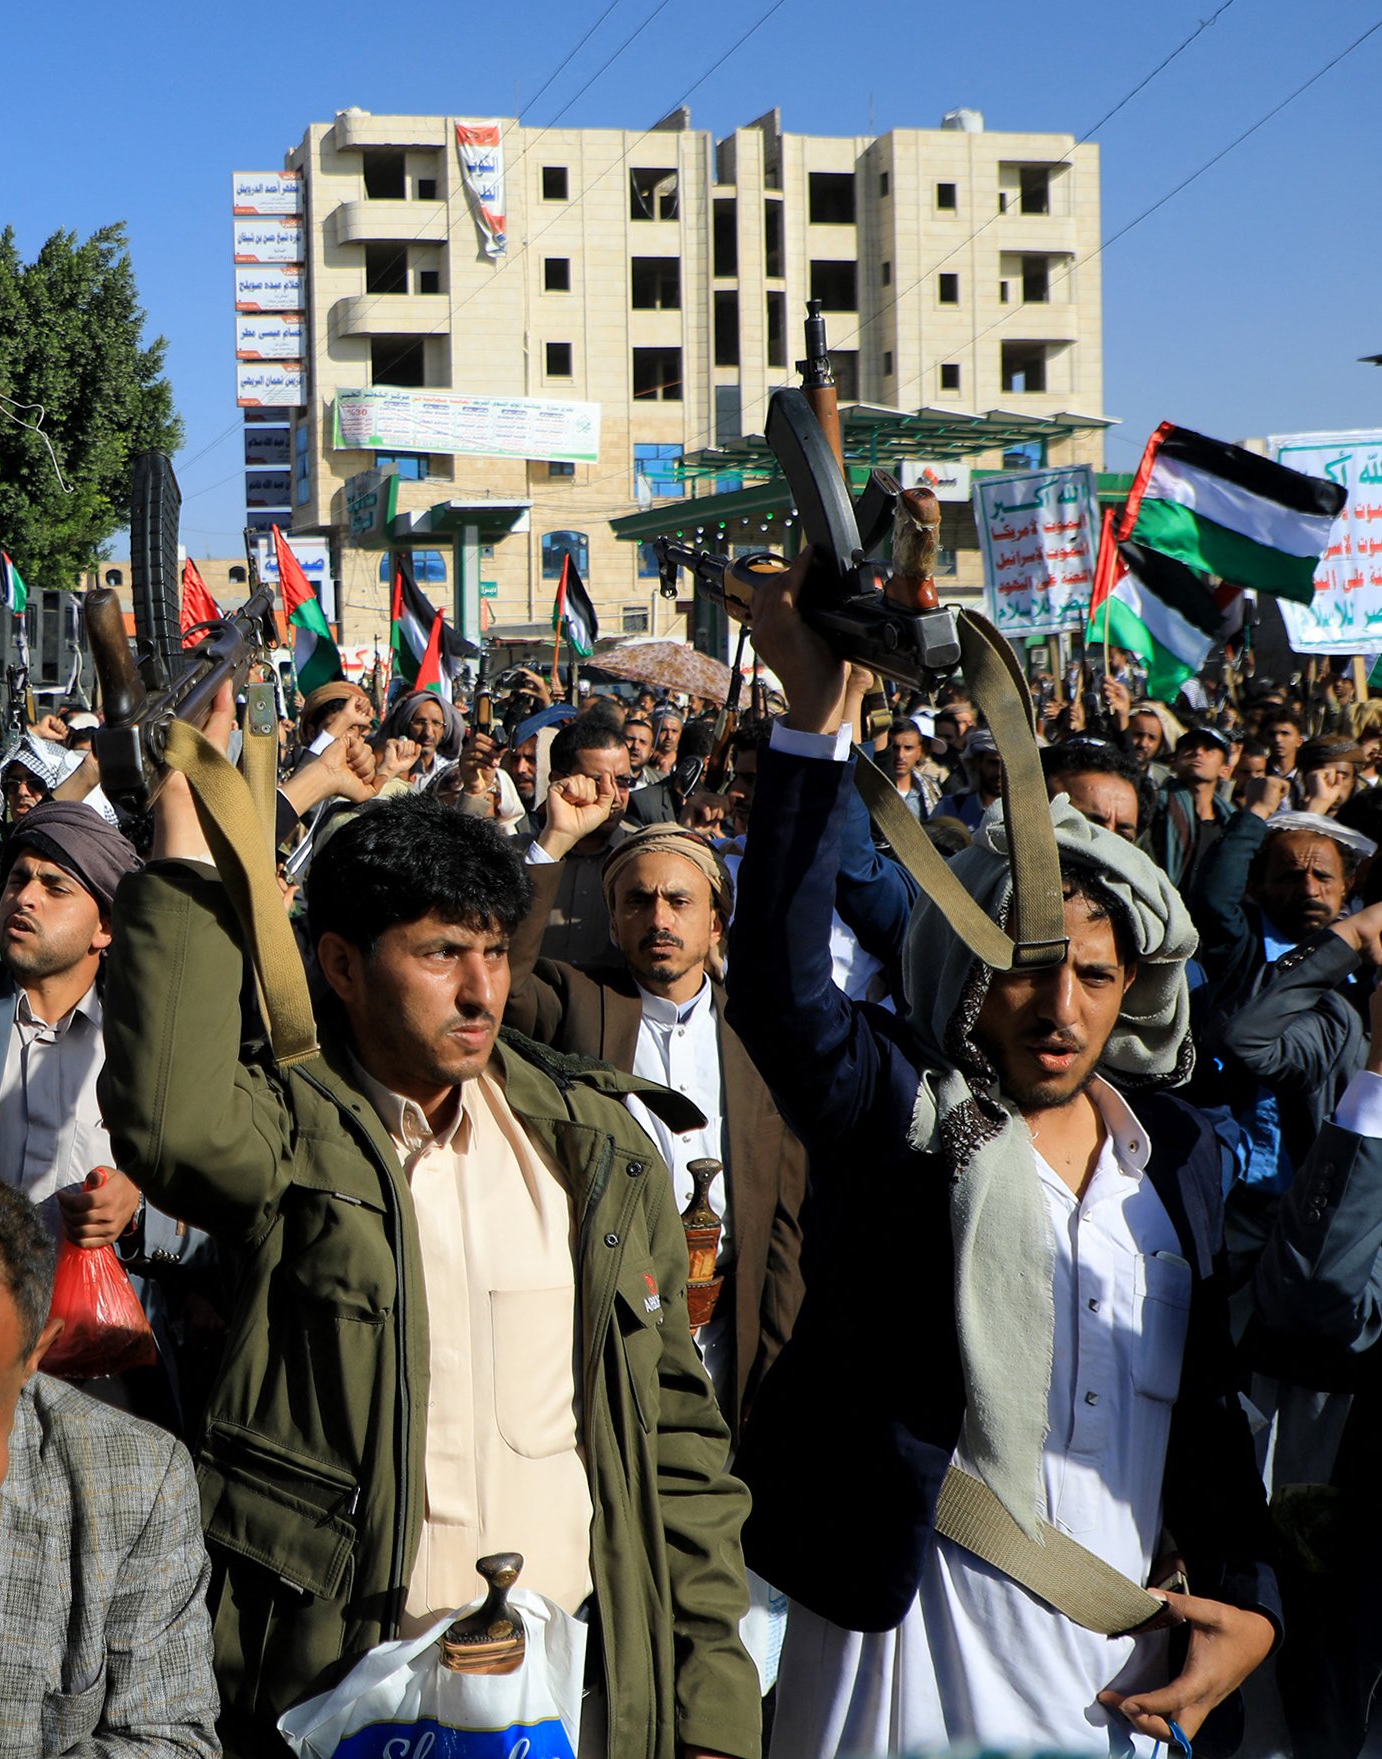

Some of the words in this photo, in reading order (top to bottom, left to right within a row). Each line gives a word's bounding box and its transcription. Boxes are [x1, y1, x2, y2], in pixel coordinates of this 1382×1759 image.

[1359, 452, 1382, 485] لله
[1057, 474, 1086, 505] الله
[1354, 504, 1382, 523] موت
[1042, 514, 1087, 535] الموت
[1046, 541, 1090, 561] الموت
[1357, 536, 1382, 557] موت
[998, 576, 1032, 596] اليهود
[1035, 574, 1057, 592] على
[1342, 568, 1364, 593] على
